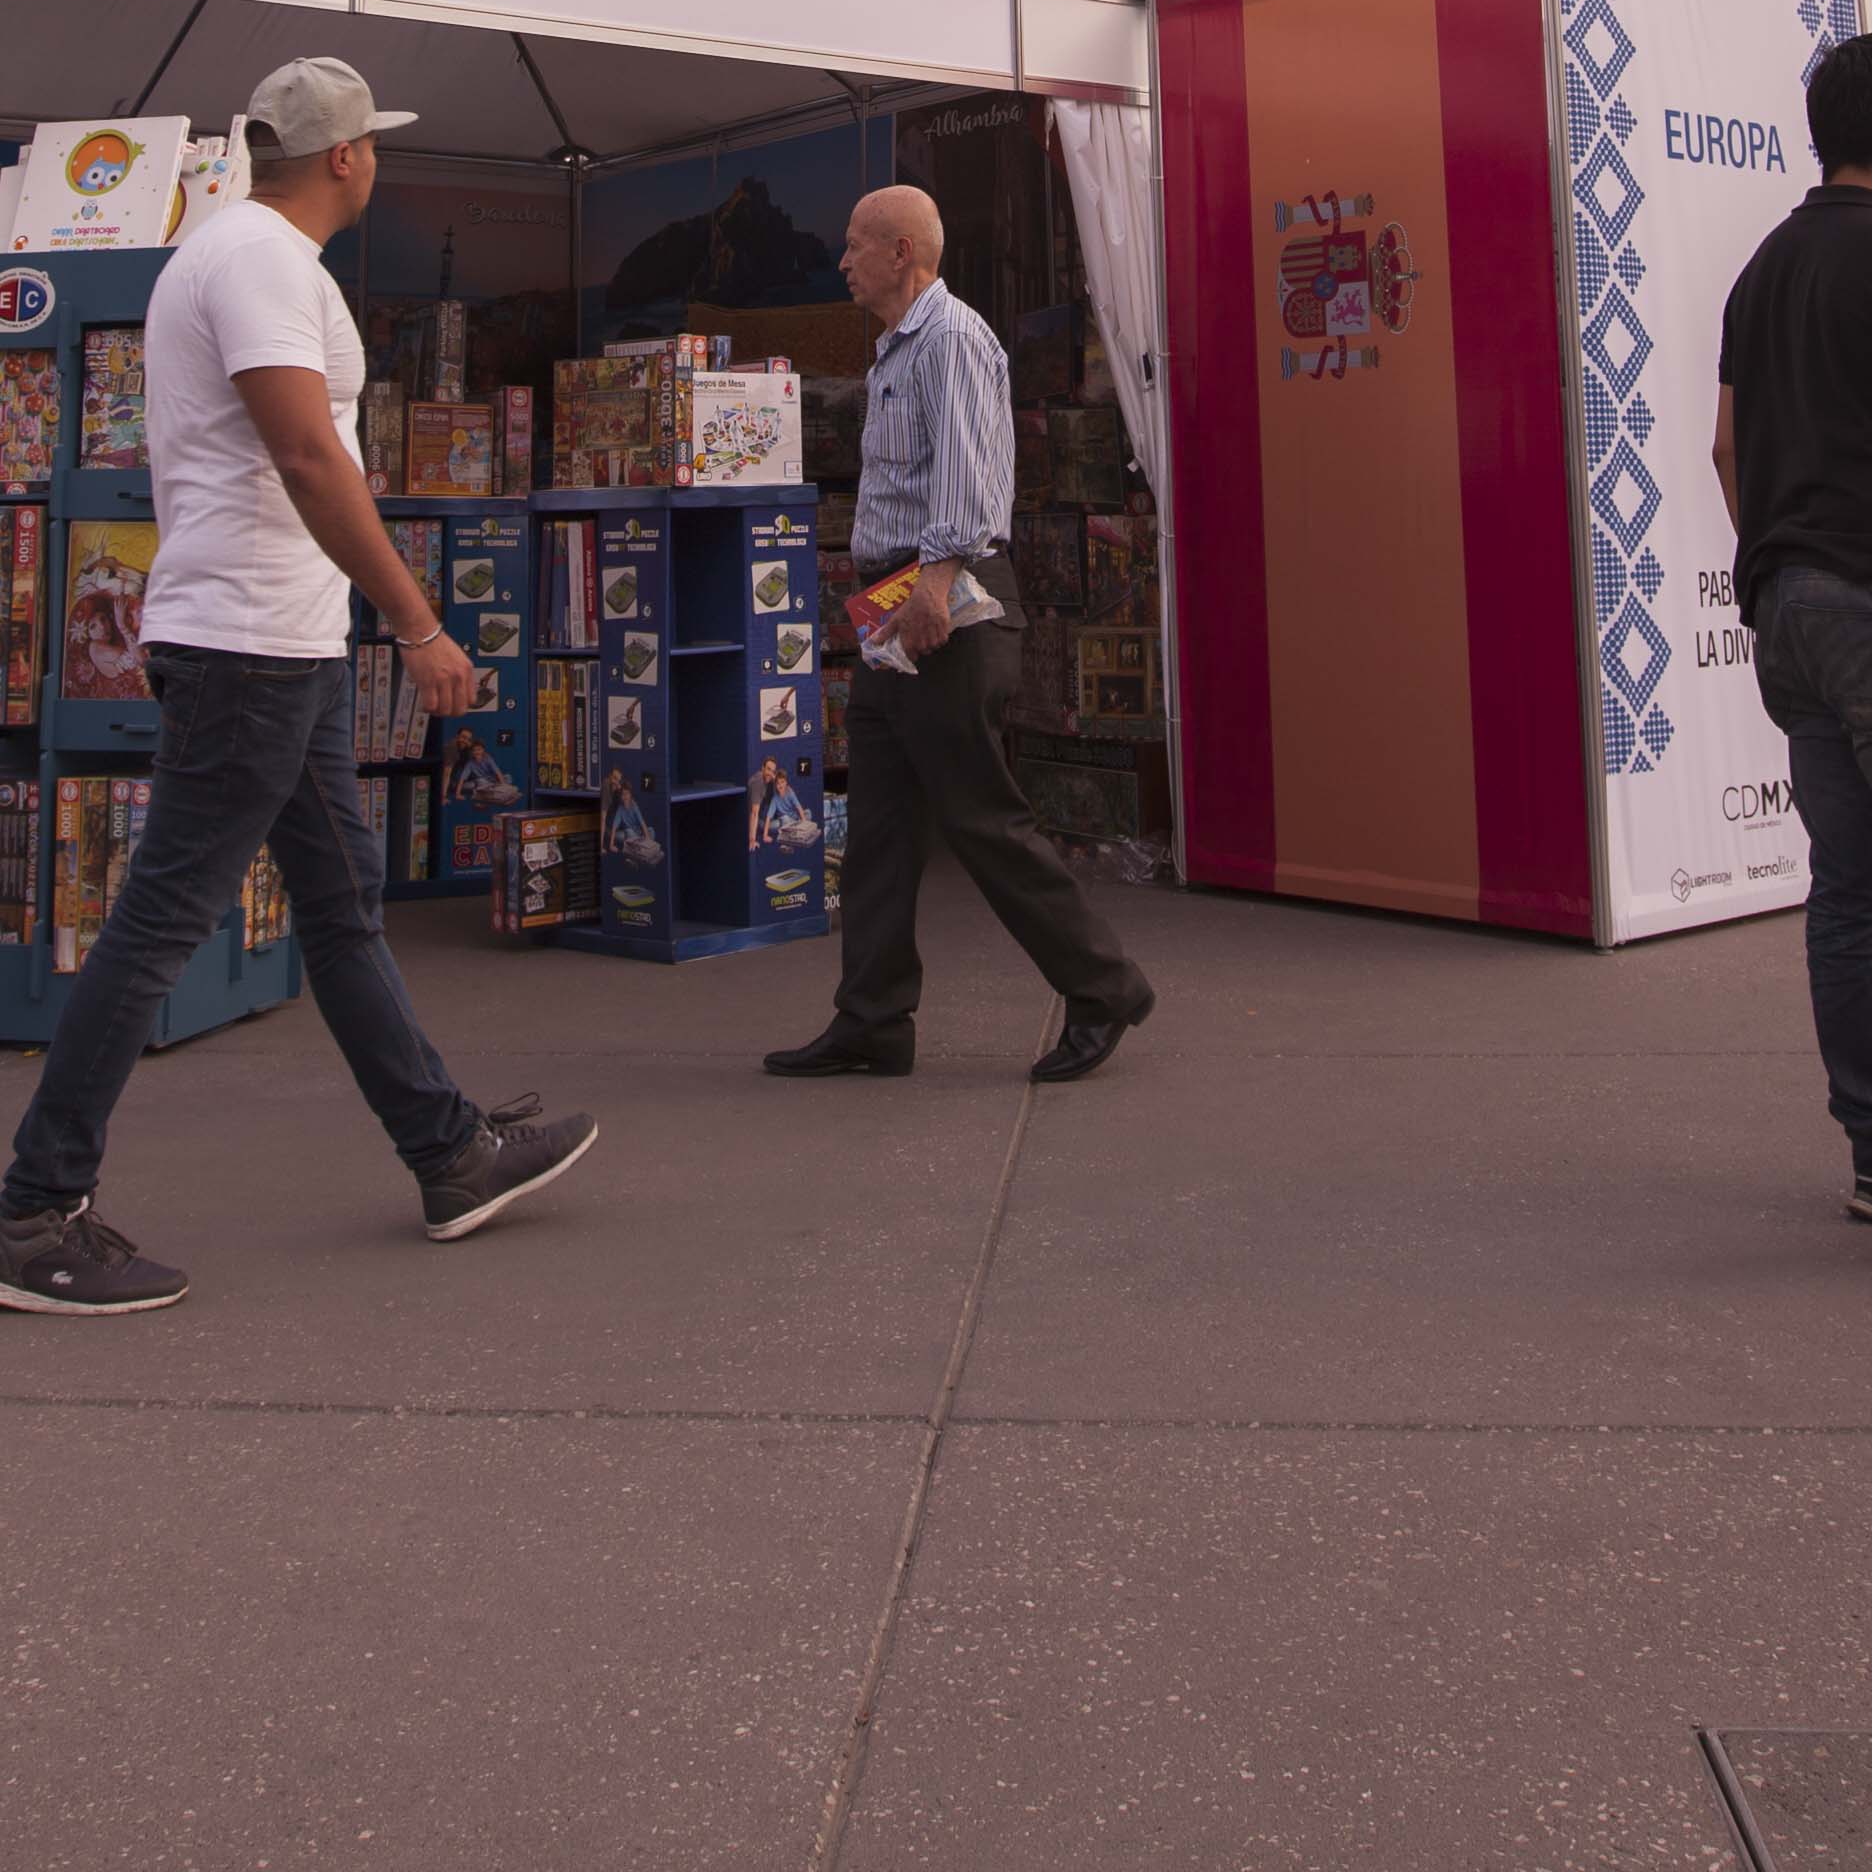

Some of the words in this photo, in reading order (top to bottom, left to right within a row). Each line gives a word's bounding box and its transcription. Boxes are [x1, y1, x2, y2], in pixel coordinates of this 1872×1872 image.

[923, 102, 1025, 143] Alhambra
[1664, 109, 1787, 174] EUROPA
[728, 378, 746, 388] Mesa
[660, 380, 673, 428] 3000
[18, 531, 30, 563] 1500
[1696, 631, 1718, 668] LA
[1723, 629, 1756, 666] DIV
[1722, 779, 1799, 822] CDMX
[60, 805, 71, 839] 1000
[112, 803, 124, 838] 1000
[1690, 871, 1733, 889] LIGHTROOM
[1747, 856, 1798, 880] tecnolite
